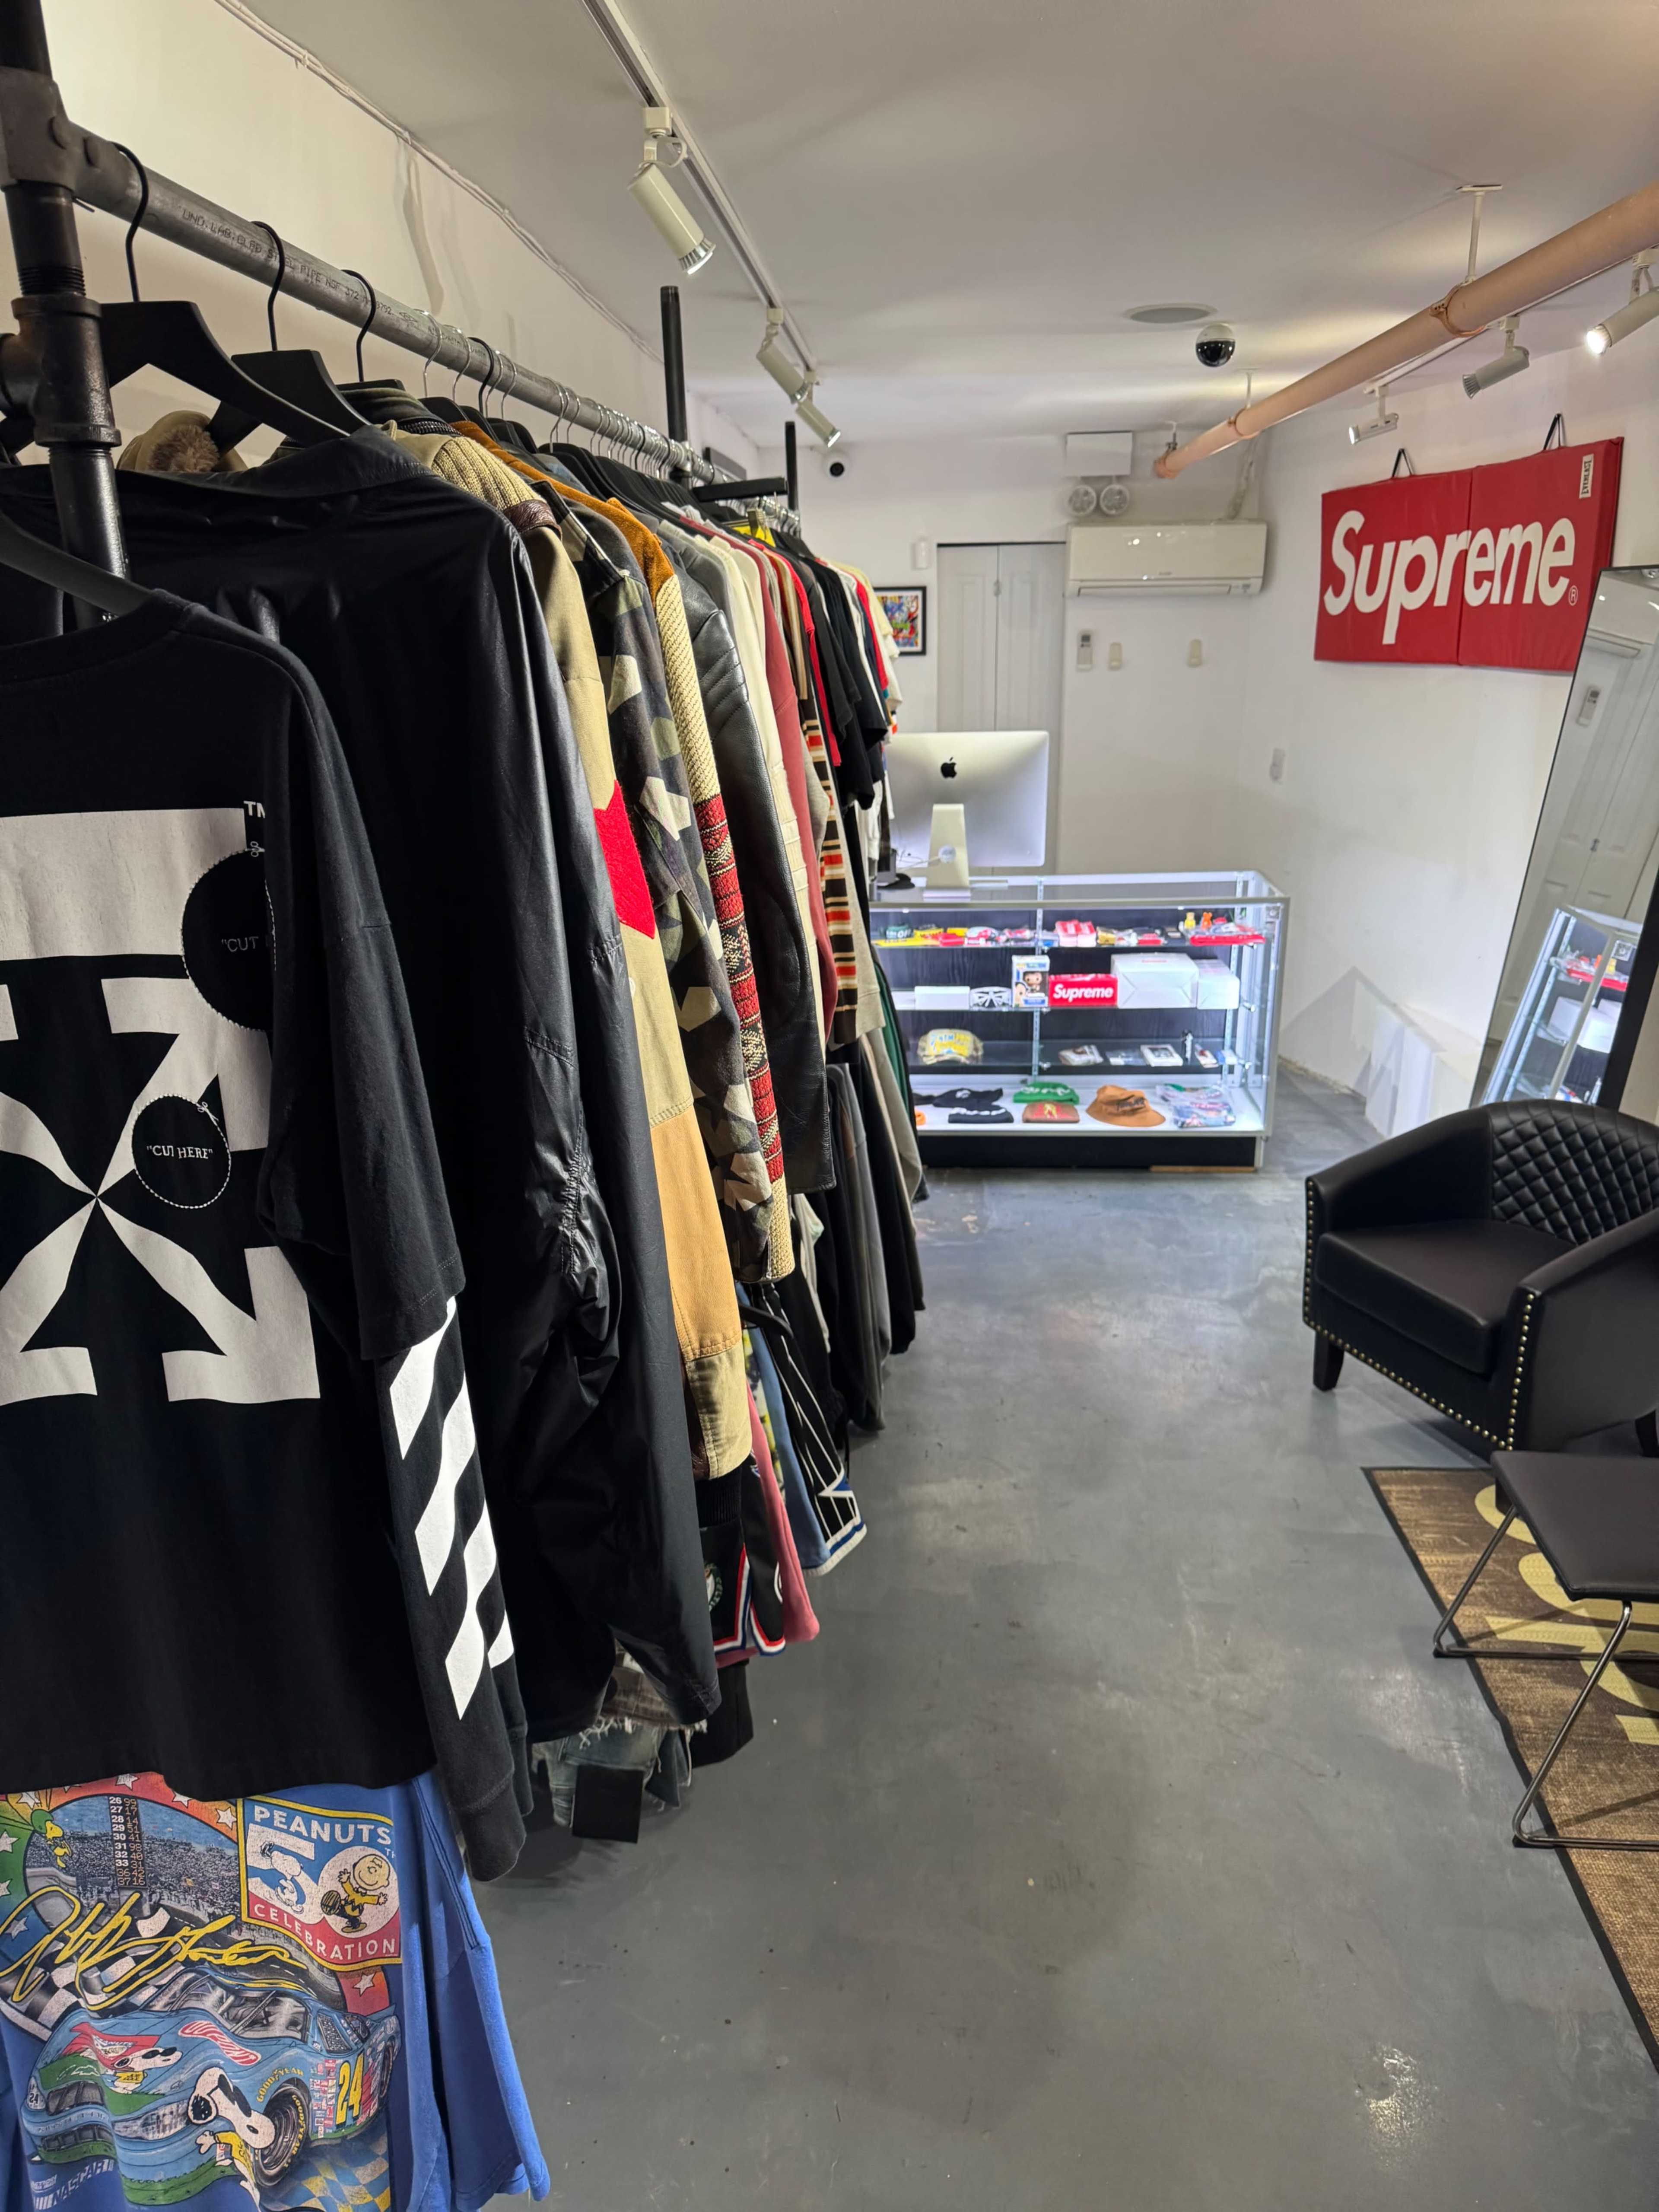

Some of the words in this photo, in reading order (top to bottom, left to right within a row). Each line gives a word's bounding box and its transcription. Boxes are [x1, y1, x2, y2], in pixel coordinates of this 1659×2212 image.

[267, 248, 294, 269] STEL
[1324, 510, 1576, 644] Supreme
[1053, 983, 1114, 1003] Supreme
[177, 1147, 213, 1159] HERE"
[254, 1805, 392, 1845] PEANUTS
[254, 1904, 395, 1961] CELEBRATION
[29, 2093, 39, 2104] 24
[256, 2067, 304, 2103] GOODYEAR
[336, 2052, 364, 2127] 24
